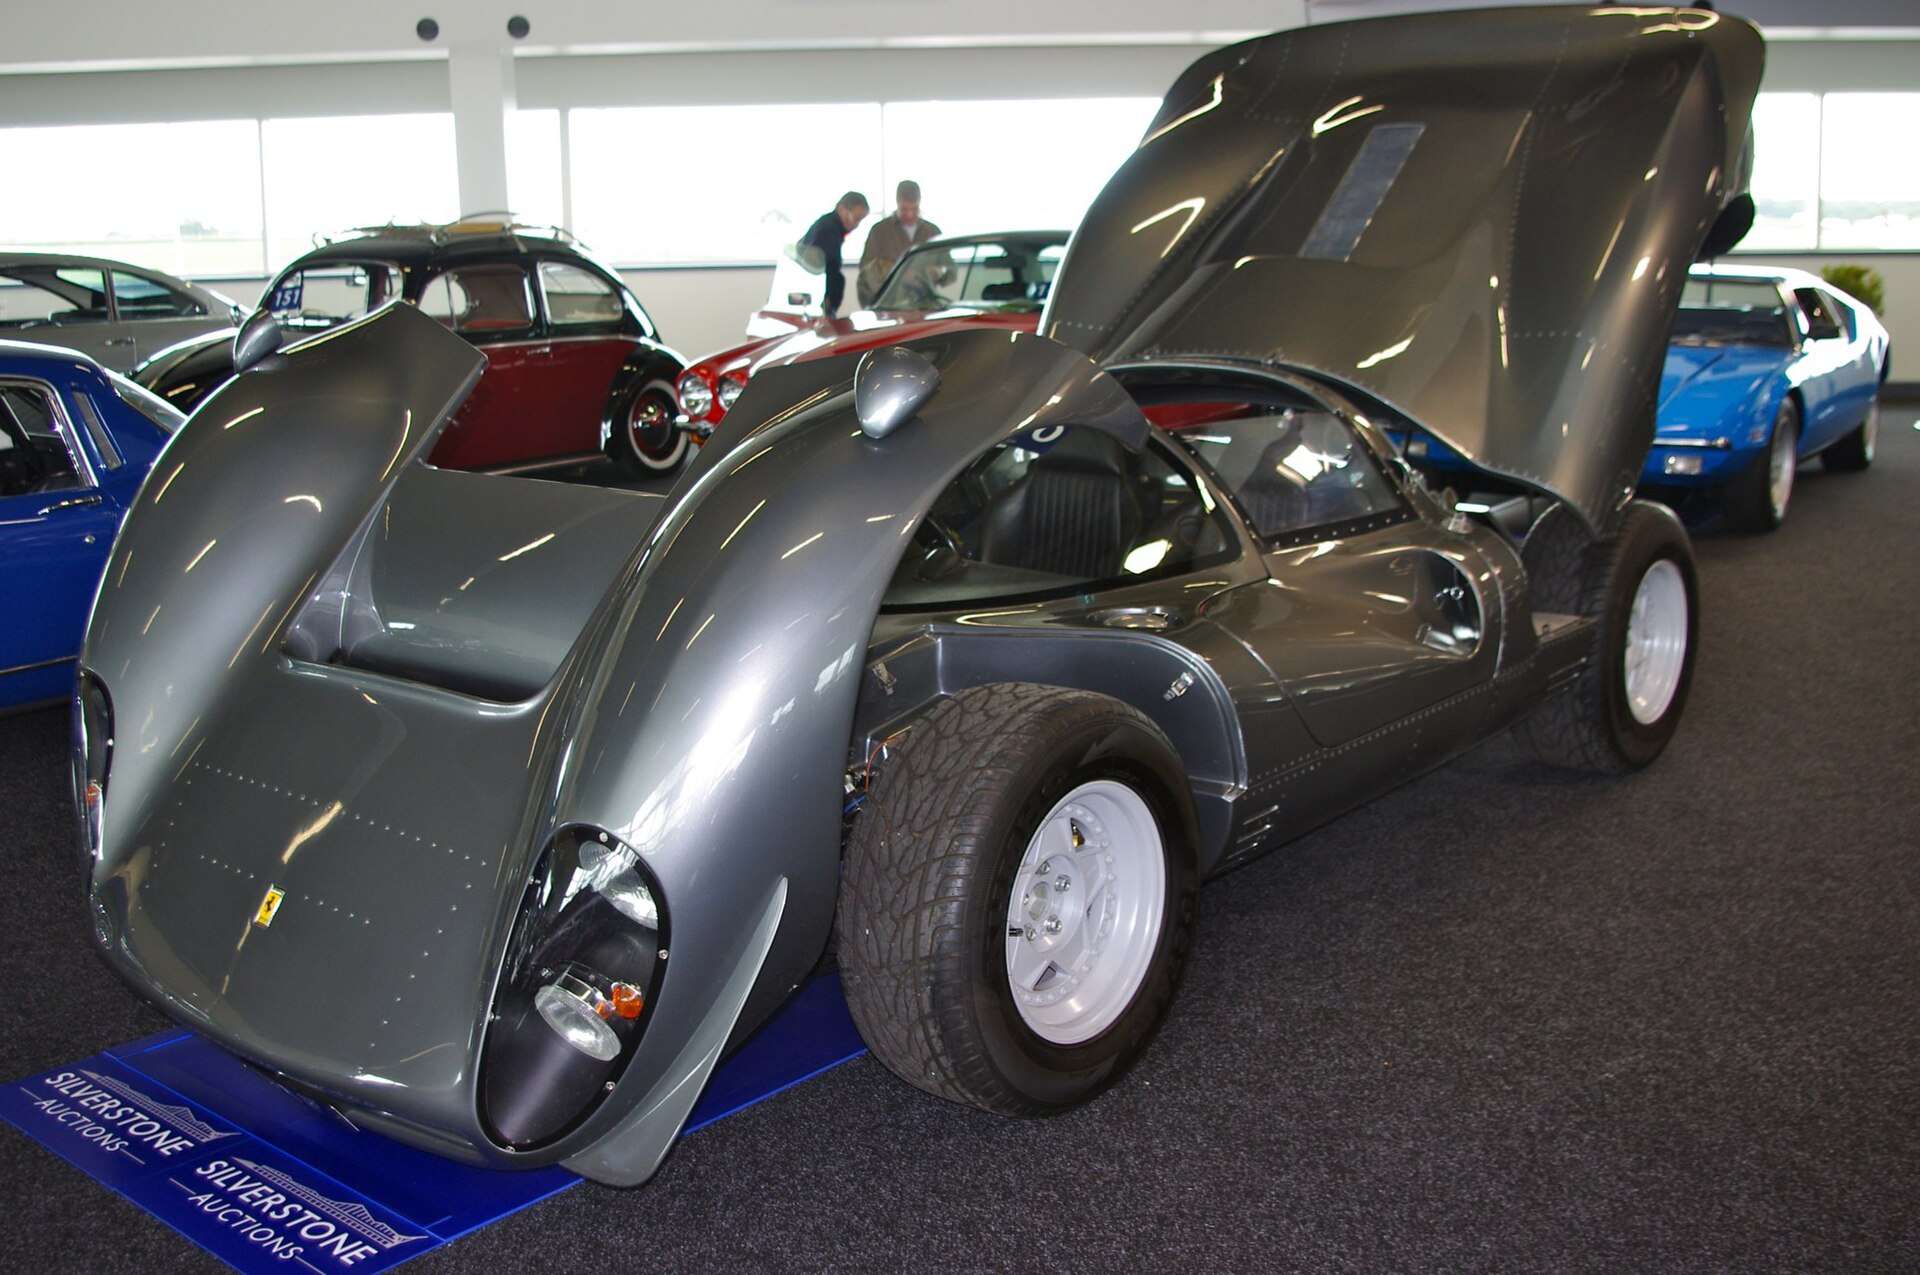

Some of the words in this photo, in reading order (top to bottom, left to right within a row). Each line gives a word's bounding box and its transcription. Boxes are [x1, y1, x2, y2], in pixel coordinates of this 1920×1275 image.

[275, 290, 299, 307] 151
[36, 1098, 128, 1153] AUCTIONS
[45, 1072, 195, 1157] SILVERSTONE
[190, 1193, 303, 1261] AUCTIONS
[196, 1160, 377, 1265] SILVERSTONE
